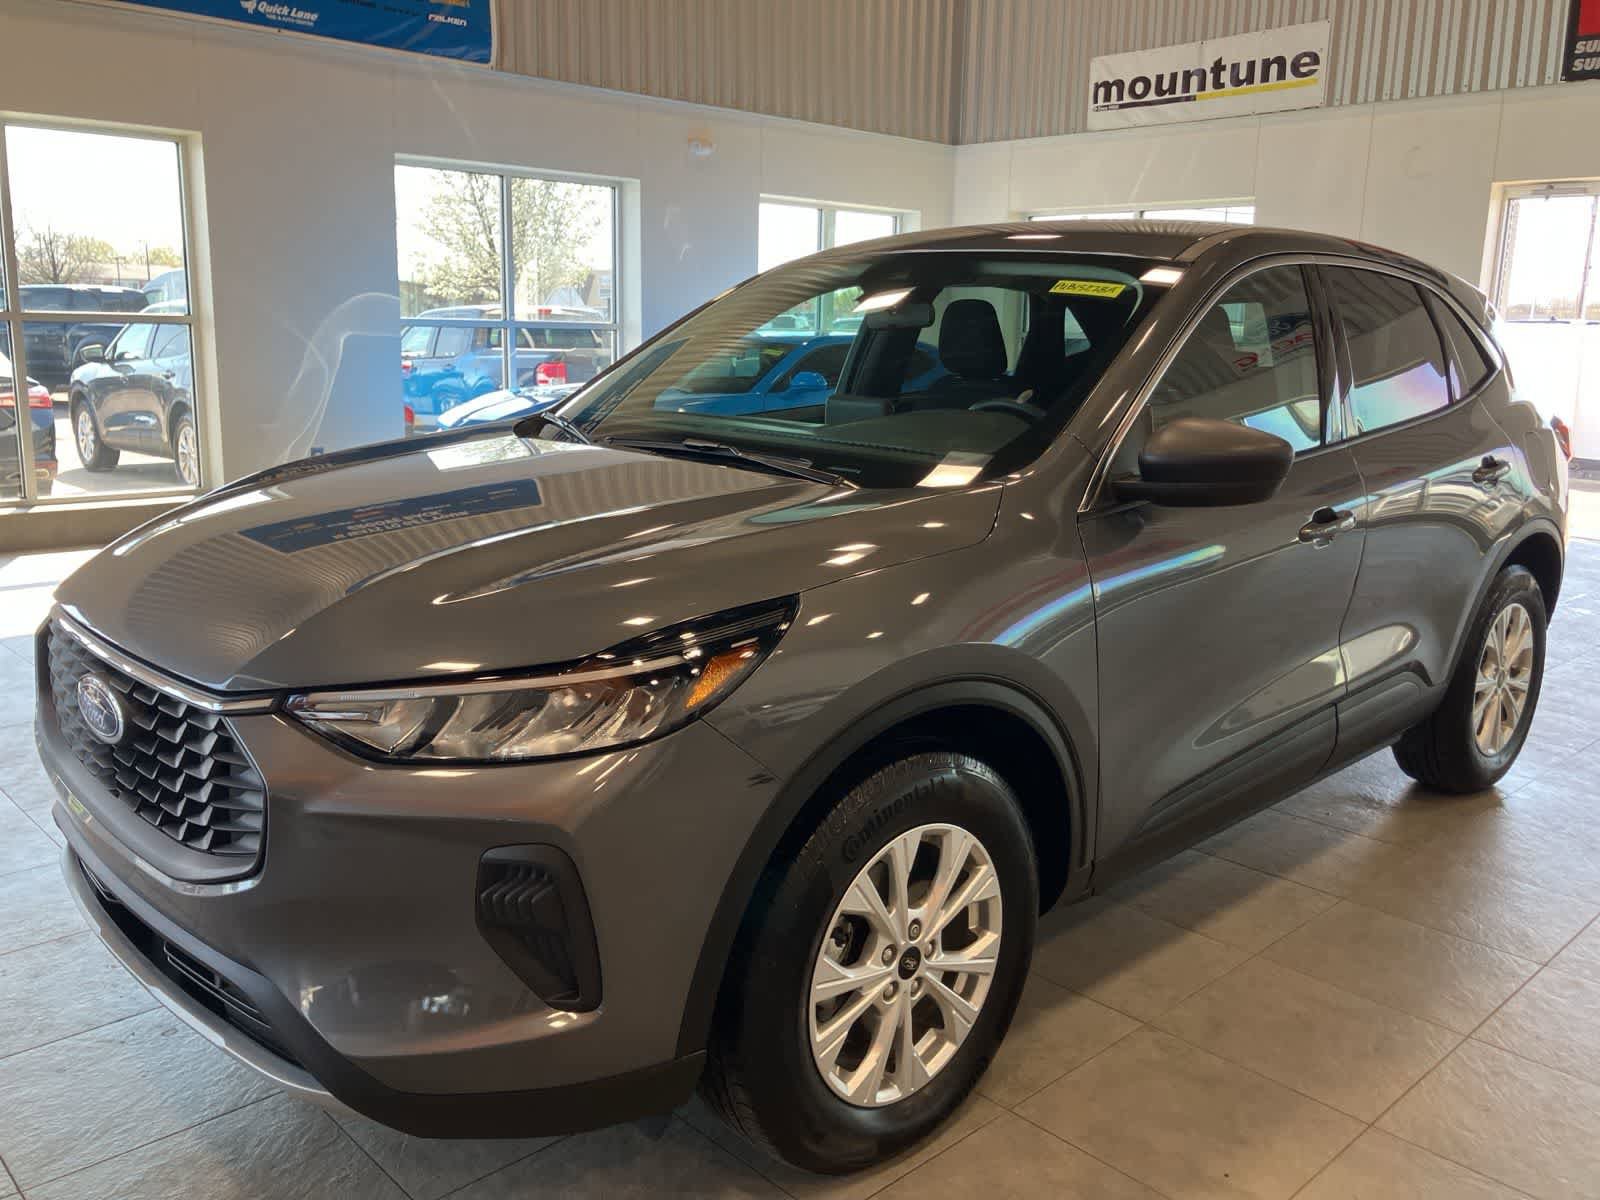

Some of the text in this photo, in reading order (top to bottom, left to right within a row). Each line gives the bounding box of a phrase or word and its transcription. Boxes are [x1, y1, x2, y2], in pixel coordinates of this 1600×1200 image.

[257, 1, 290, 16] Quick
[290, 8, 319, 21] Lane
[428, 13, 467, 27] FALKEN
[1092, 50, 1320, 104] mountune
[841, 777, 935, 864] Continental
